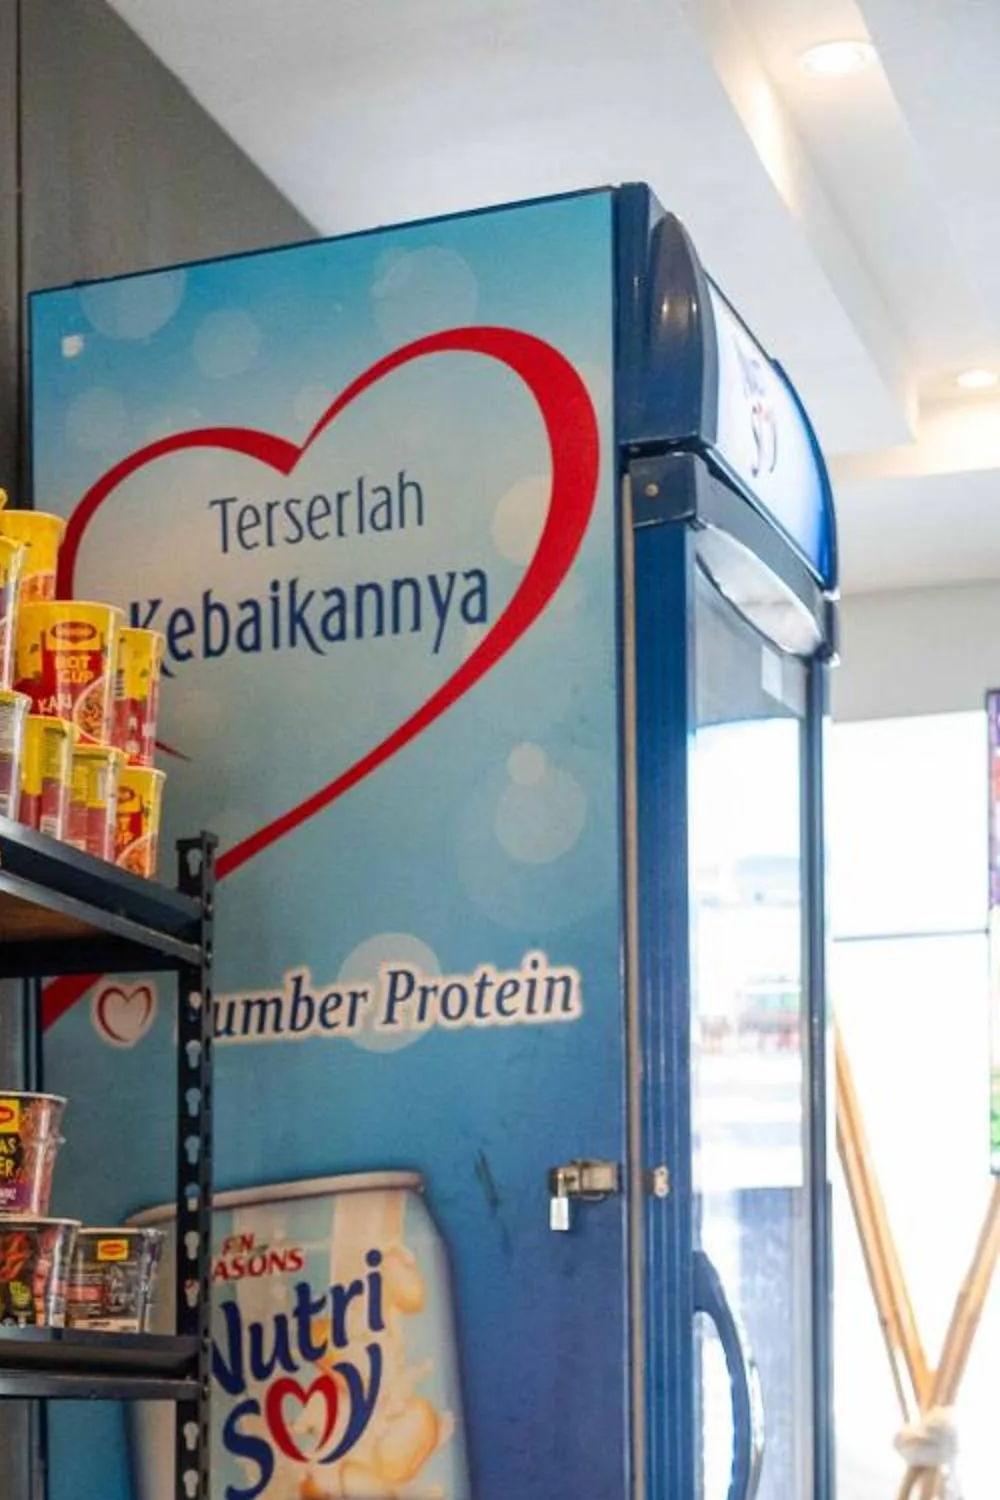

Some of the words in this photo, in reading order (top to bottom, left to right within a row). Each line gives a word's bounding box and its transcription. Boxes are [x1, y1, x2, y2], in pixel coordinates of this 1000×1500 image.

[209, 470, 424, 555] Terserlah
[128, 567, 489, 679] Kebaikannya
[212, 973, 369, 1039] umber
[382, 958, 574, 1026] Protein
[211, 1248, 304, 1282] ASONS
[211, 1248, 385, 1396] Nutri
